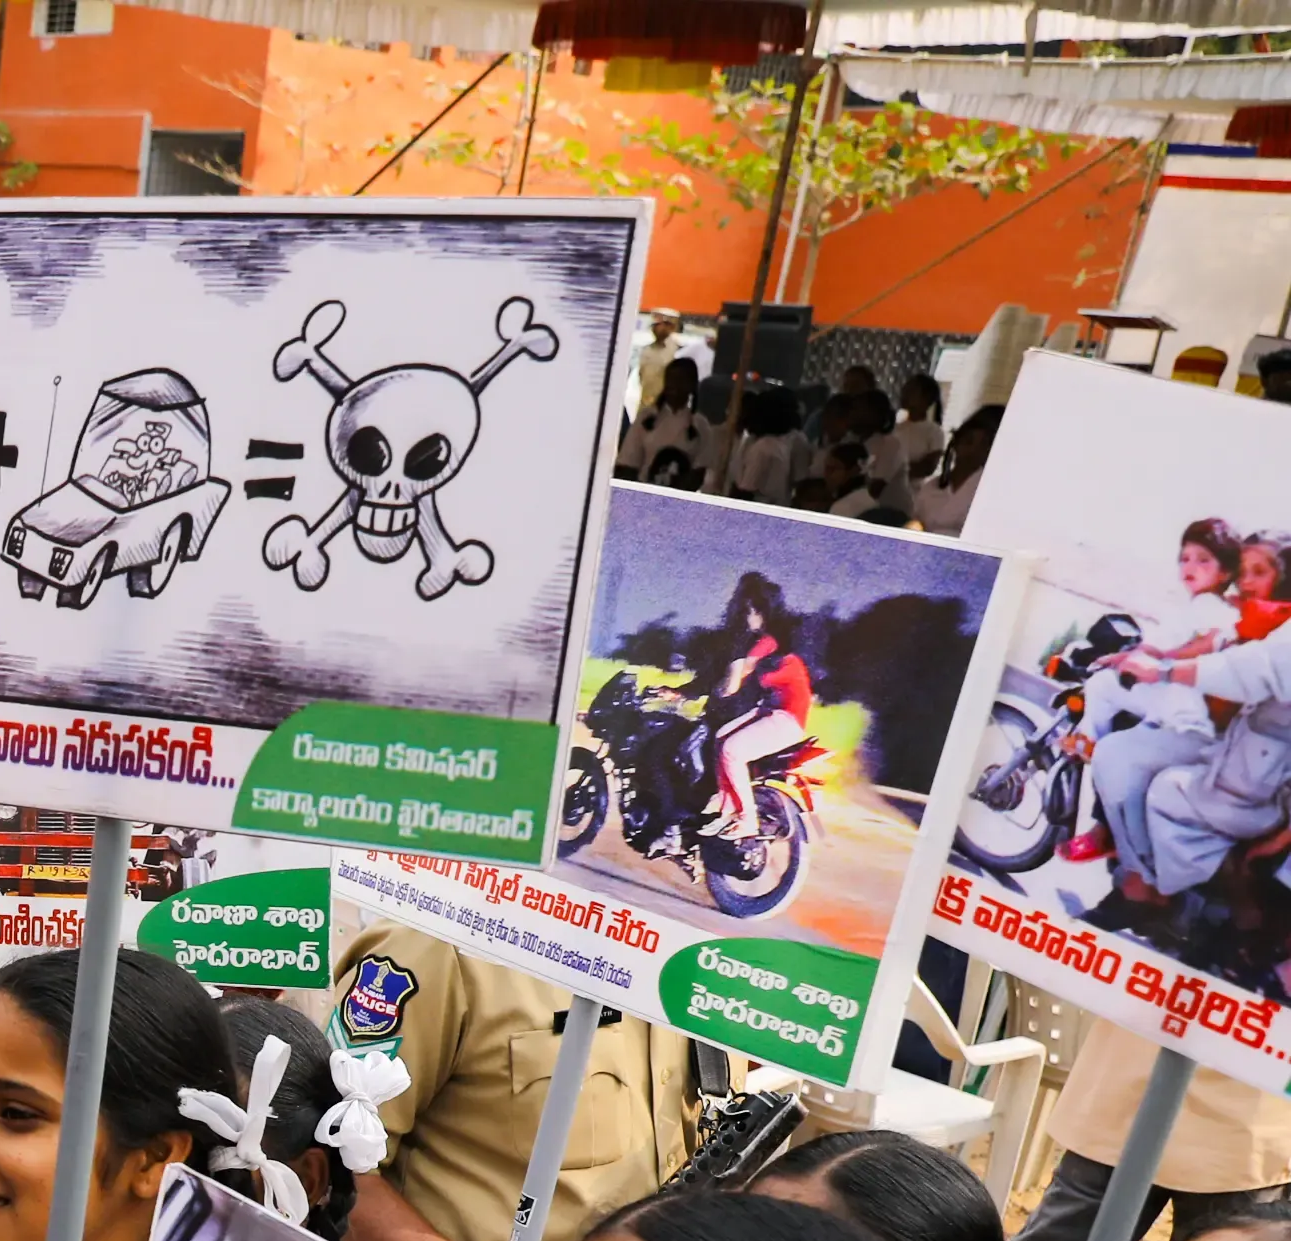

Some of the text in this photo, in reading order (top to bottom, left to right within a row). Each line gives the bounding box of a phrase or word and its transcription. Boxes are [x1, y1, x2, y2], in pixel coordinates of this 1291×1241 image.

[292, 734, 498, 781] రవాణా కమిషనర్
[251, 786, 534, 842] కార్యాలయం ఖైరతాబాద్
[171, 897, 325, 932] రవాణా శాఖ
[522, 885, 606, 934] జంపింగ్
[606, 910, 660, 954] నేరం
[973, 895, 1122, 985] వాహనం
[172, 939, 321, 974] హైదరాబాద్
[697, 946, 860, 1020] రవాణా శాఖ
[351, 987, 397, 1016] POLICE
[687, 982, 848, 1057] హైదరాబాద్
